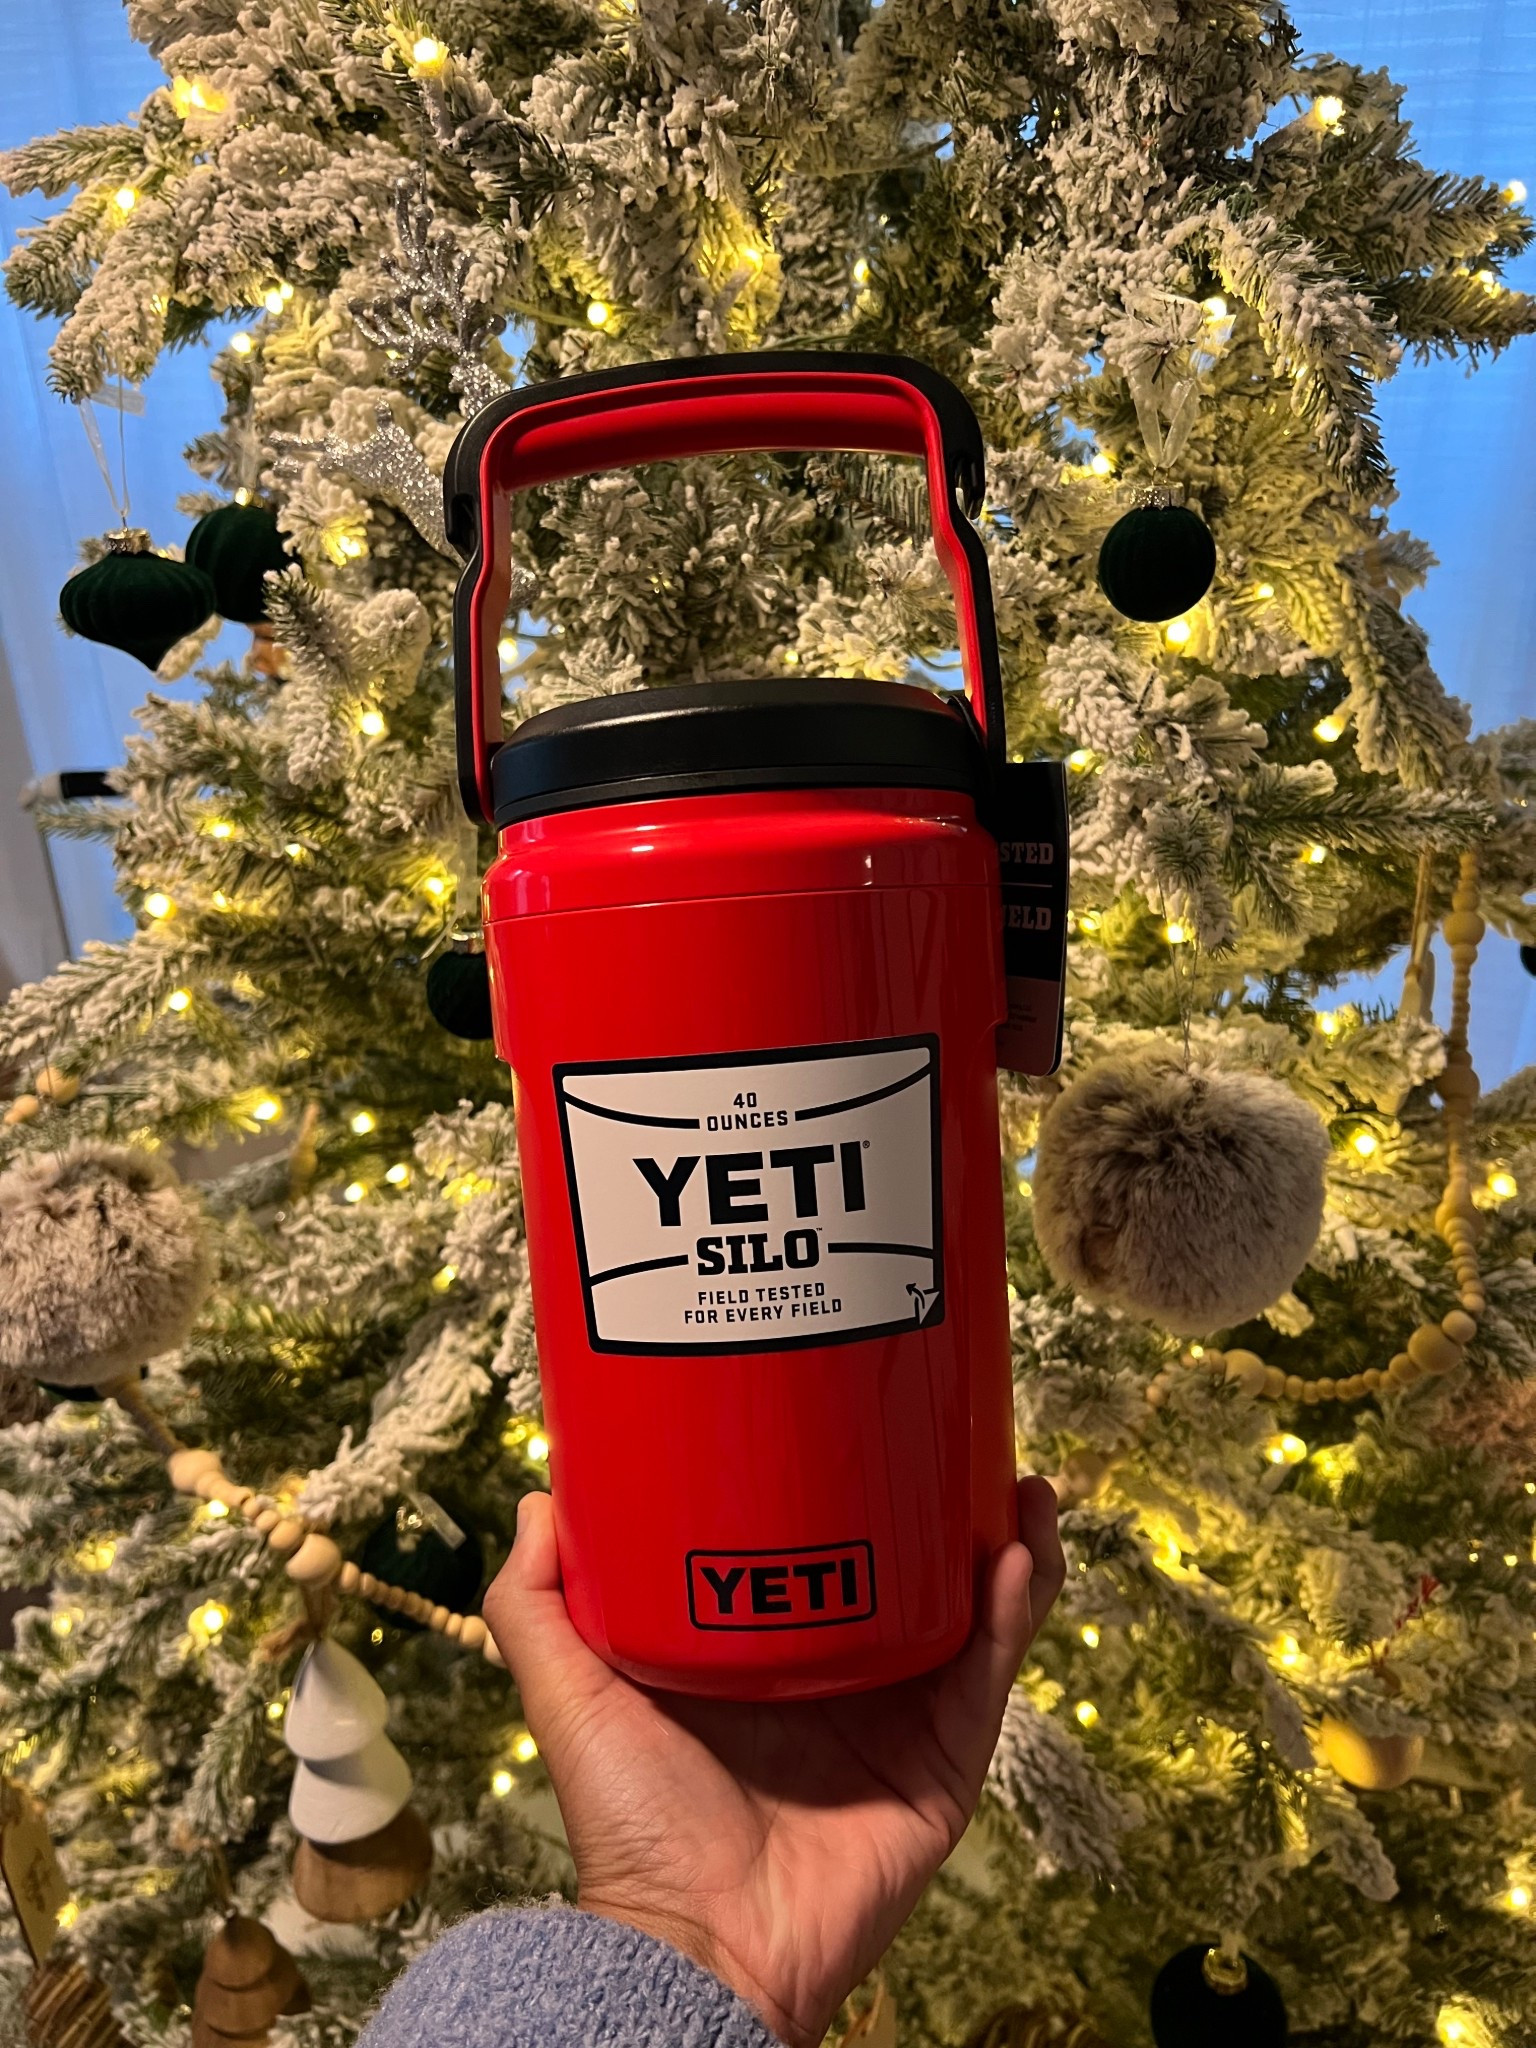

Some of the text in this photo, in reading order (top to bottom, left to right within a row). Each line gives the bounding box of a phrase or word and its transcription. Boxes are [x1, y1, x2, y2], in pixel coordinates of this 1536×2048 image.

[733, 1092, 757, 1109] 40
[706, 1110, 788, 1132] OUNCES
[632, 1140, 867, 1228] YETI
[695, 1228, 820, 1276] SILO
[698, 1282, 825, 1306] FIELD TESTED
[684, 1298, 842, 1324] FOR EVERY FIELD
[699, 1557, 859, 1615] YETI
